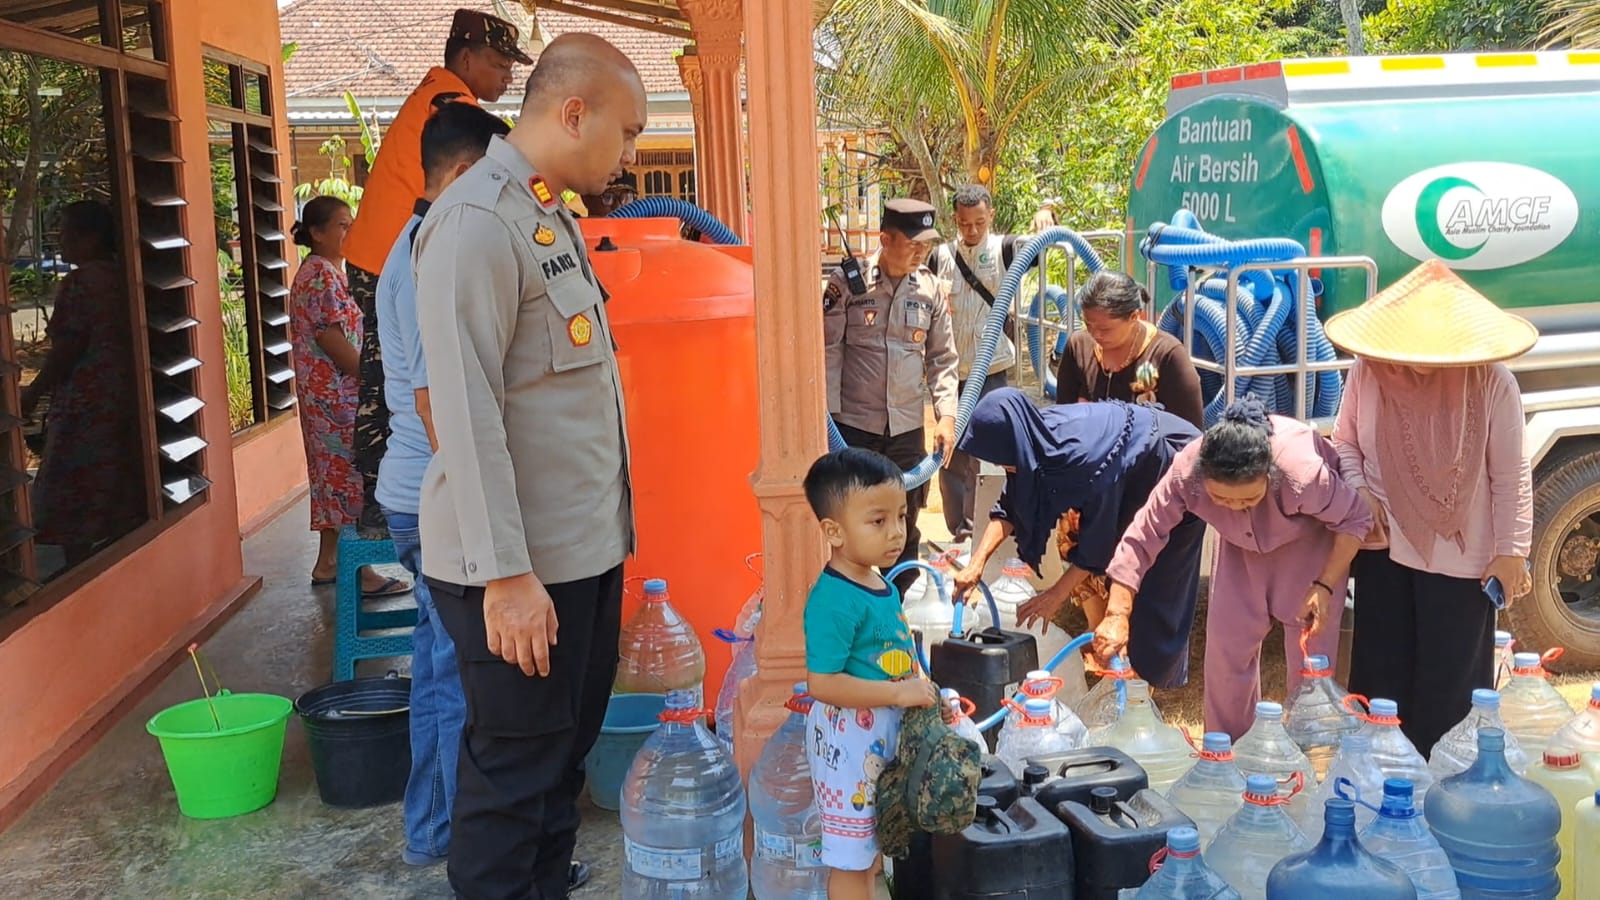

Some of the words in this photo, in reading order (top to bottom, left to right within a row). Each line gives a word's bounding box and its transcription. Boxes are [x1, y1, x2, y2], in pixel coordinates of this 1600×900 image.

[1178, 114, 1252, 144] Bantuan
[1170, 154, 1195, 183] Air
[1199, 152, 1259, 183] Bersih
[1182, 191, 1220, 221] 5000
[1225, 193, 1237, 223] L
[1445, 196, 1551, 229] AMCF
[1445, 227, 1461, 236] Asia
[1462, 226, 1486, 235] Muslim
[1488, 224, 1511, 233] Charity
[1513, 223, 1551, 232] Foundation
[542, 253, 576, 280] FARIZ
